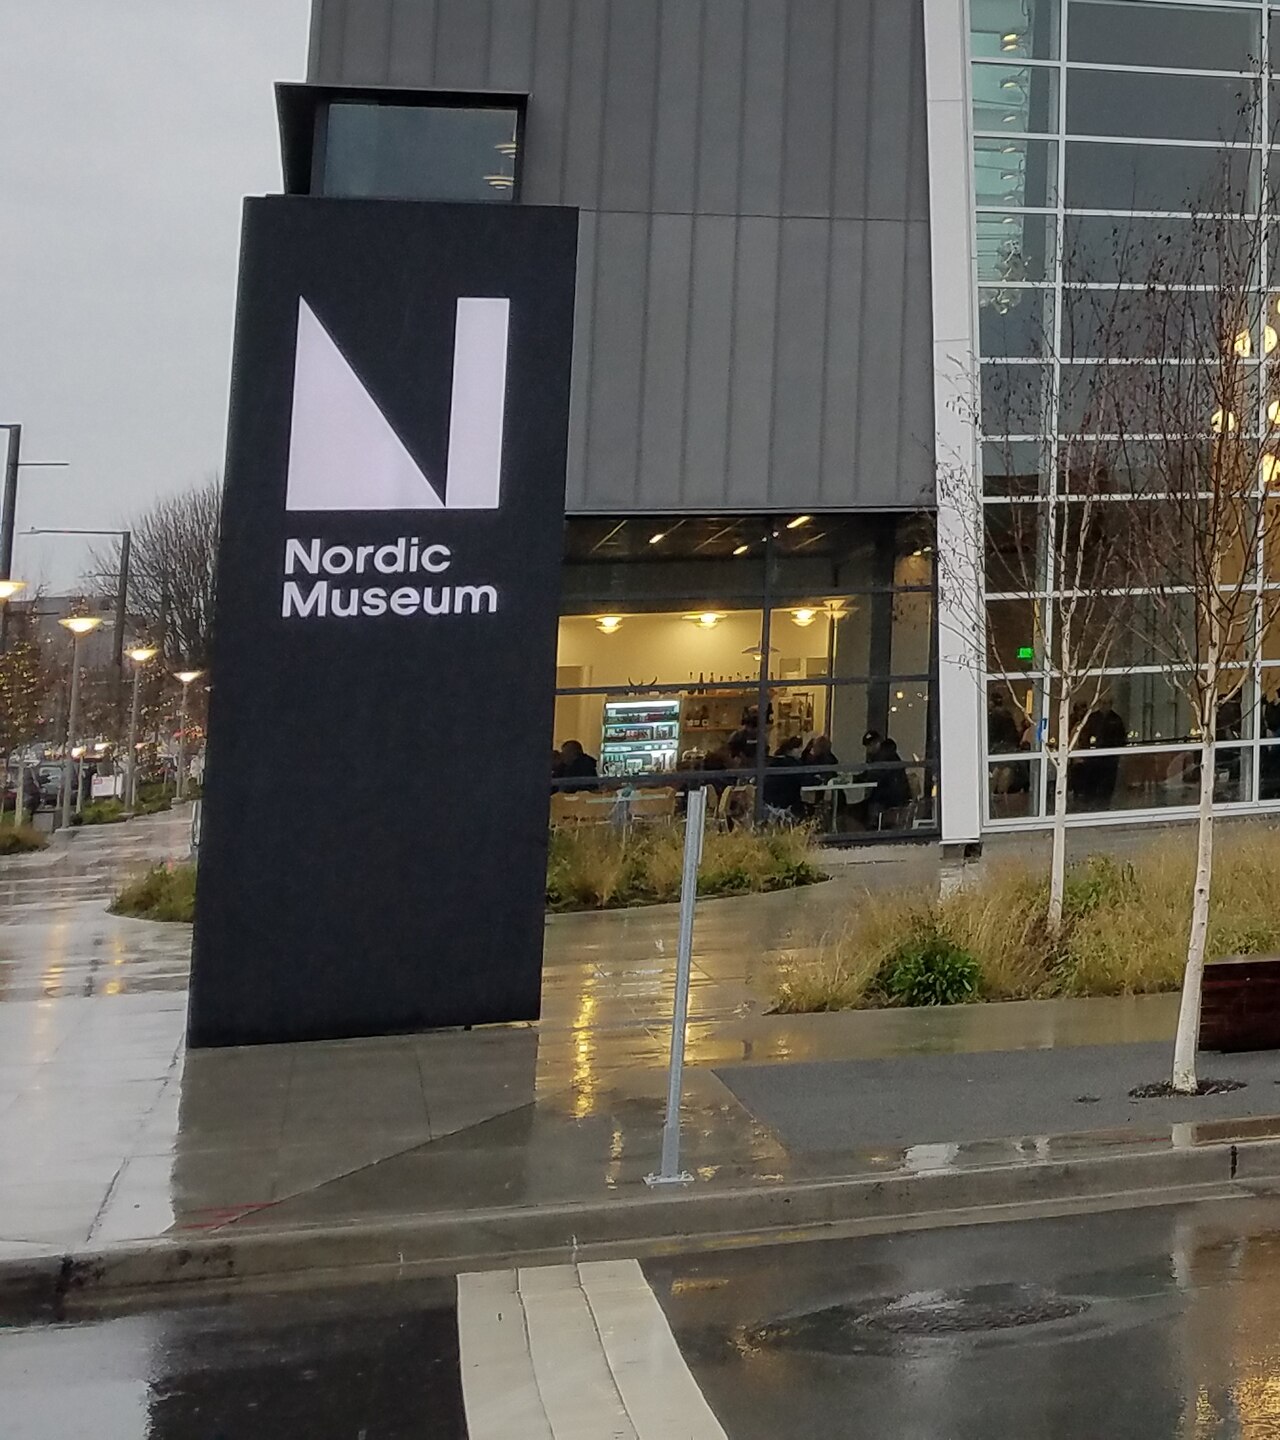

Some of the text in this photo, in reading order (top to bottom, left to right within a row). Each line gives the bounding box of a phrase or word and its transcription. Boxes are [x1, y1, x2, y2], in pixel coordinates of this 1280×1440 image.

[285, 295, 510, 511] N
[285, 537, 451, 574] Nordic
[282, 581, 498, 617] Museum
